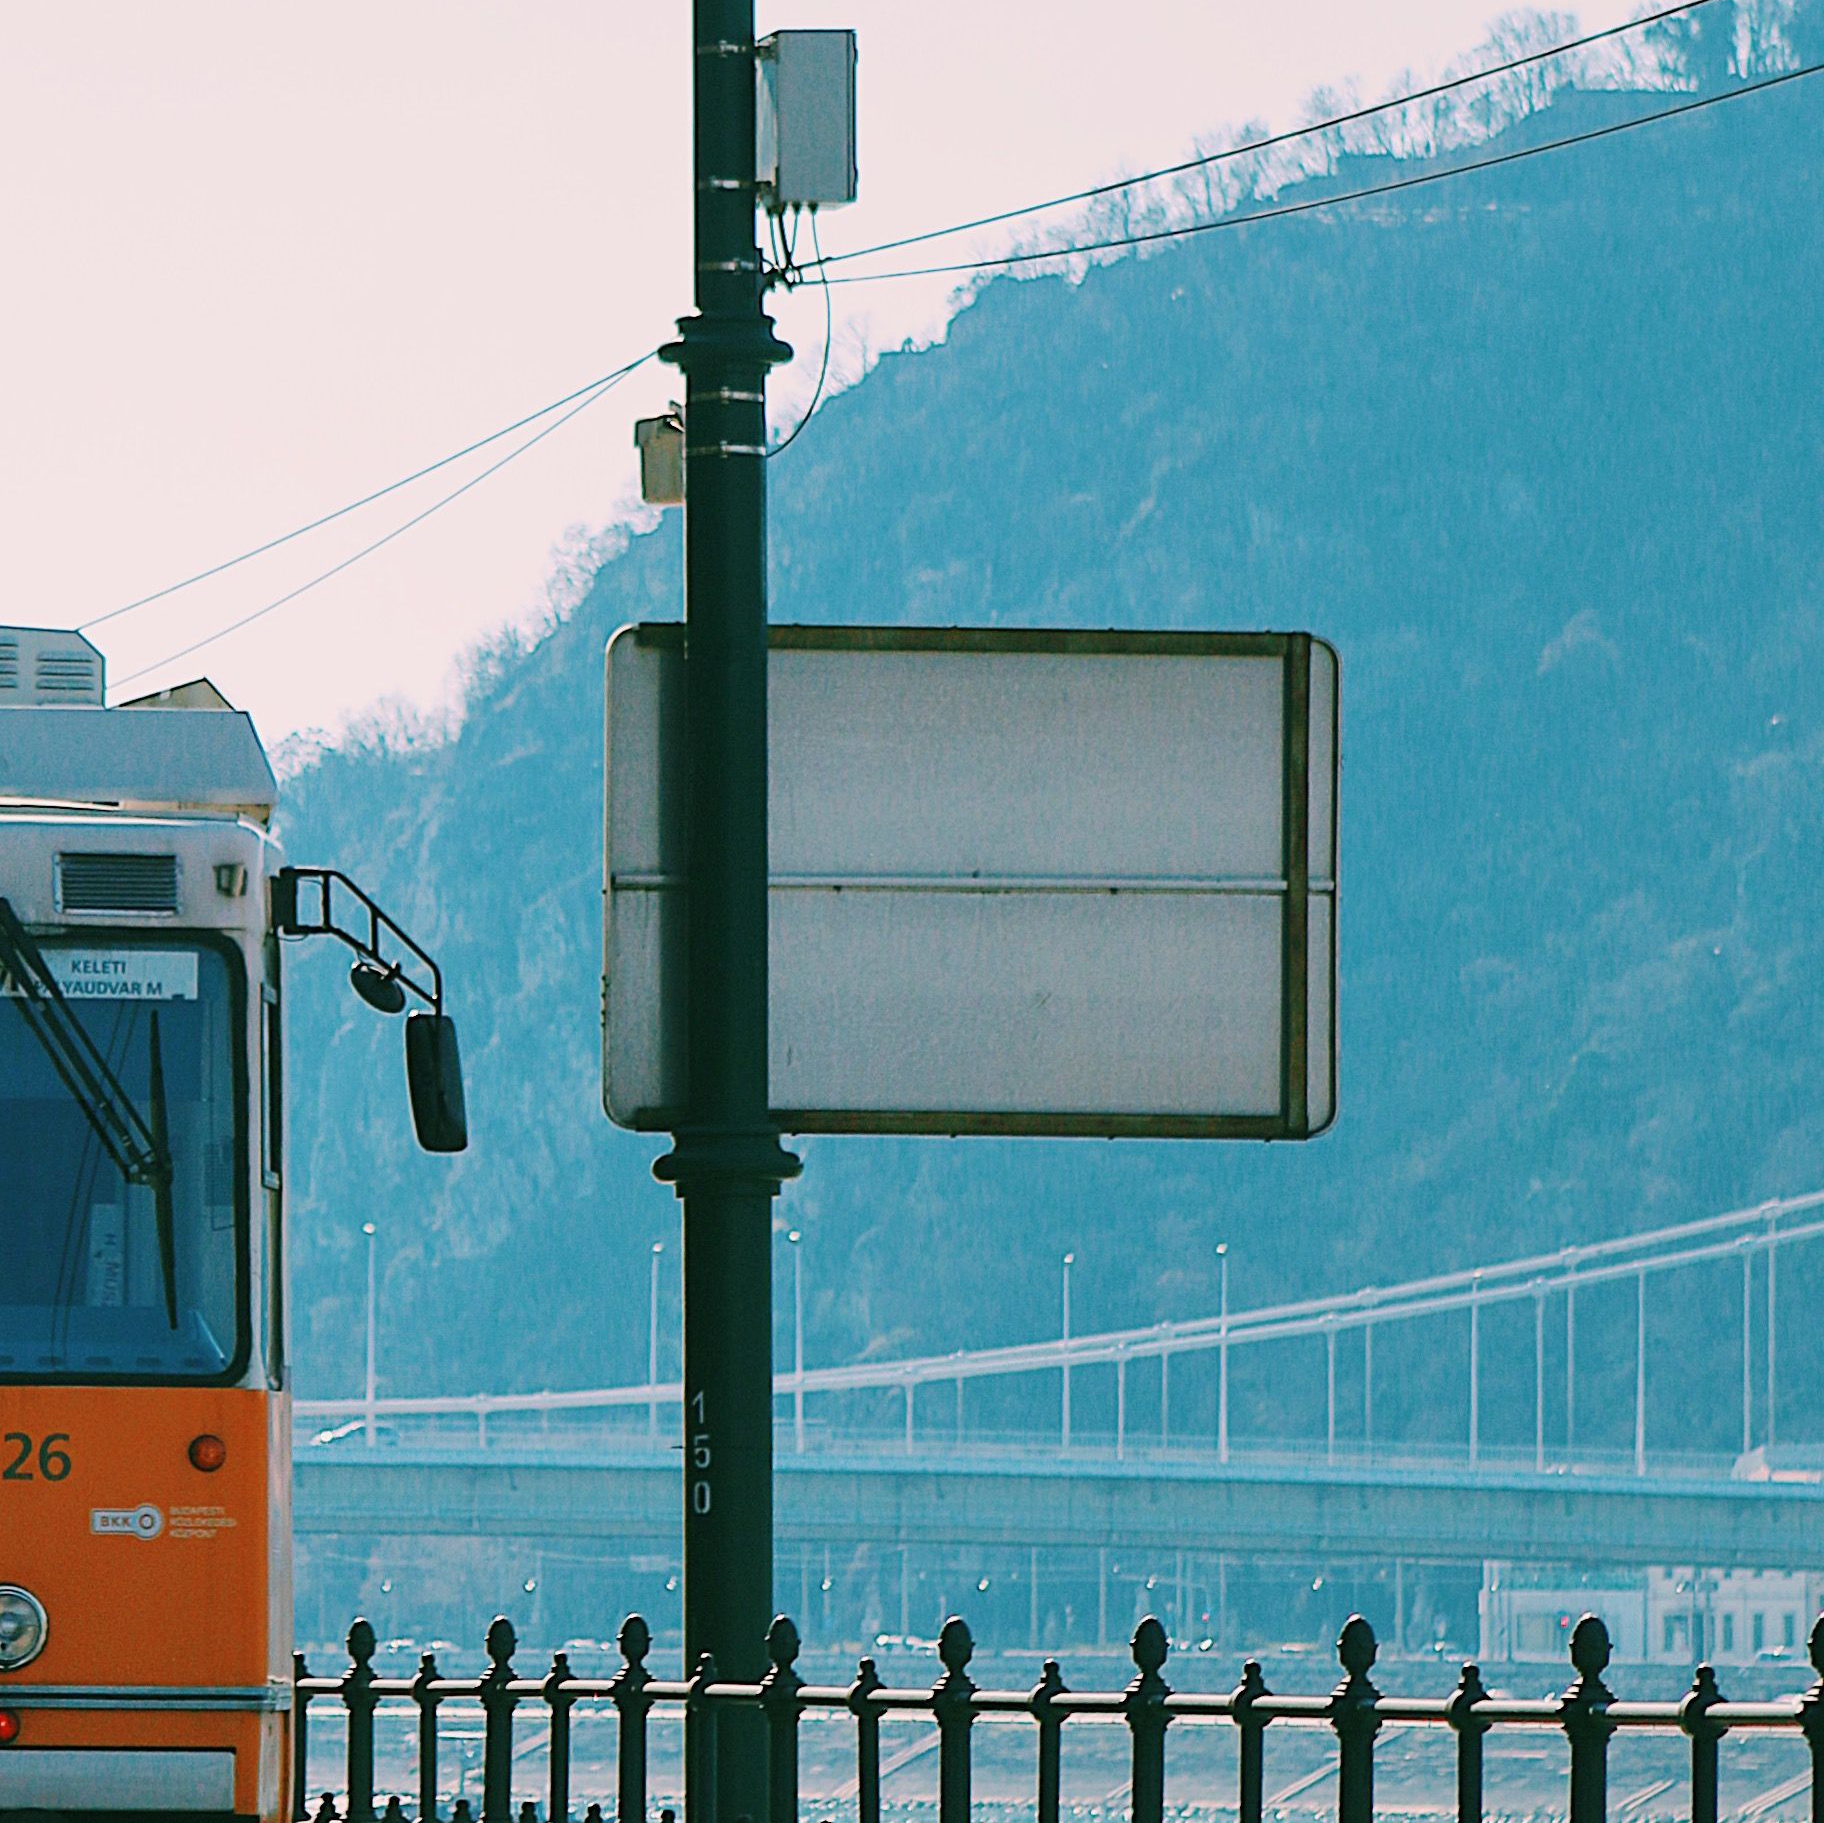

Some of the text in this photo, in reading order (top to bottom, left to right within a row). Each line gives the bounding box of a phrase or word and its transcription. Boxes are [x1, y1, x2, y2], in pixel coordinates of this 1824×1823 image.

[71, 959, 127, 975] KELETI
[33, 979, 163, 996] PYAUDVAR M
[691, 1390, 711, 1515] 150
[100, 1515, 131, 1527] BKK
